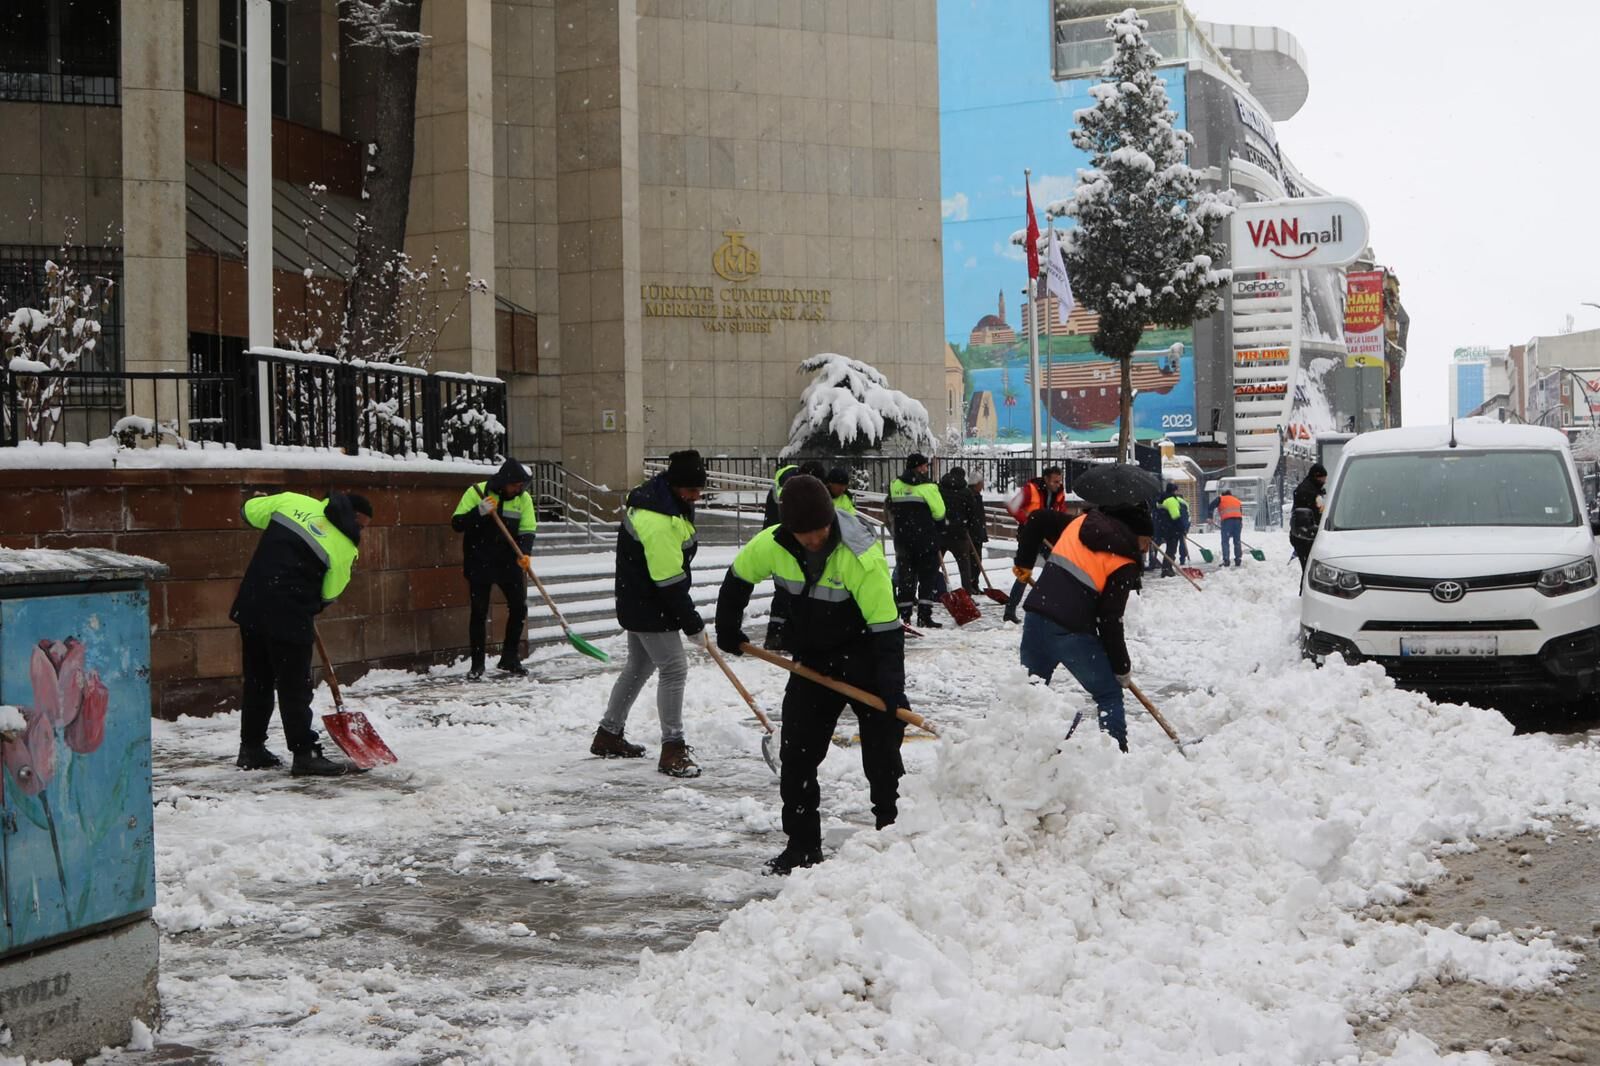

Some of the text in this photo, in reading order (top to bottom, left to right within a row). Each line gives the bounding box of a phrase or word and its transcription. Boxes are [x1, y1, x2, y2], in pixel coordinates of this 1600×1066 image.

[1247, 215, 1343, 248] VANmall
[1238, 281, 1285, 293] DeFacto
[719, 287, 831, 305] CUMHURİYET
[645, 302, 718, 319] MERKEZ
[722, 304, 795, 321] BANKASI
[702, 318, 773, 335] VAN ŞUBESİ
[1161, 413, 1193, 428] 2023
